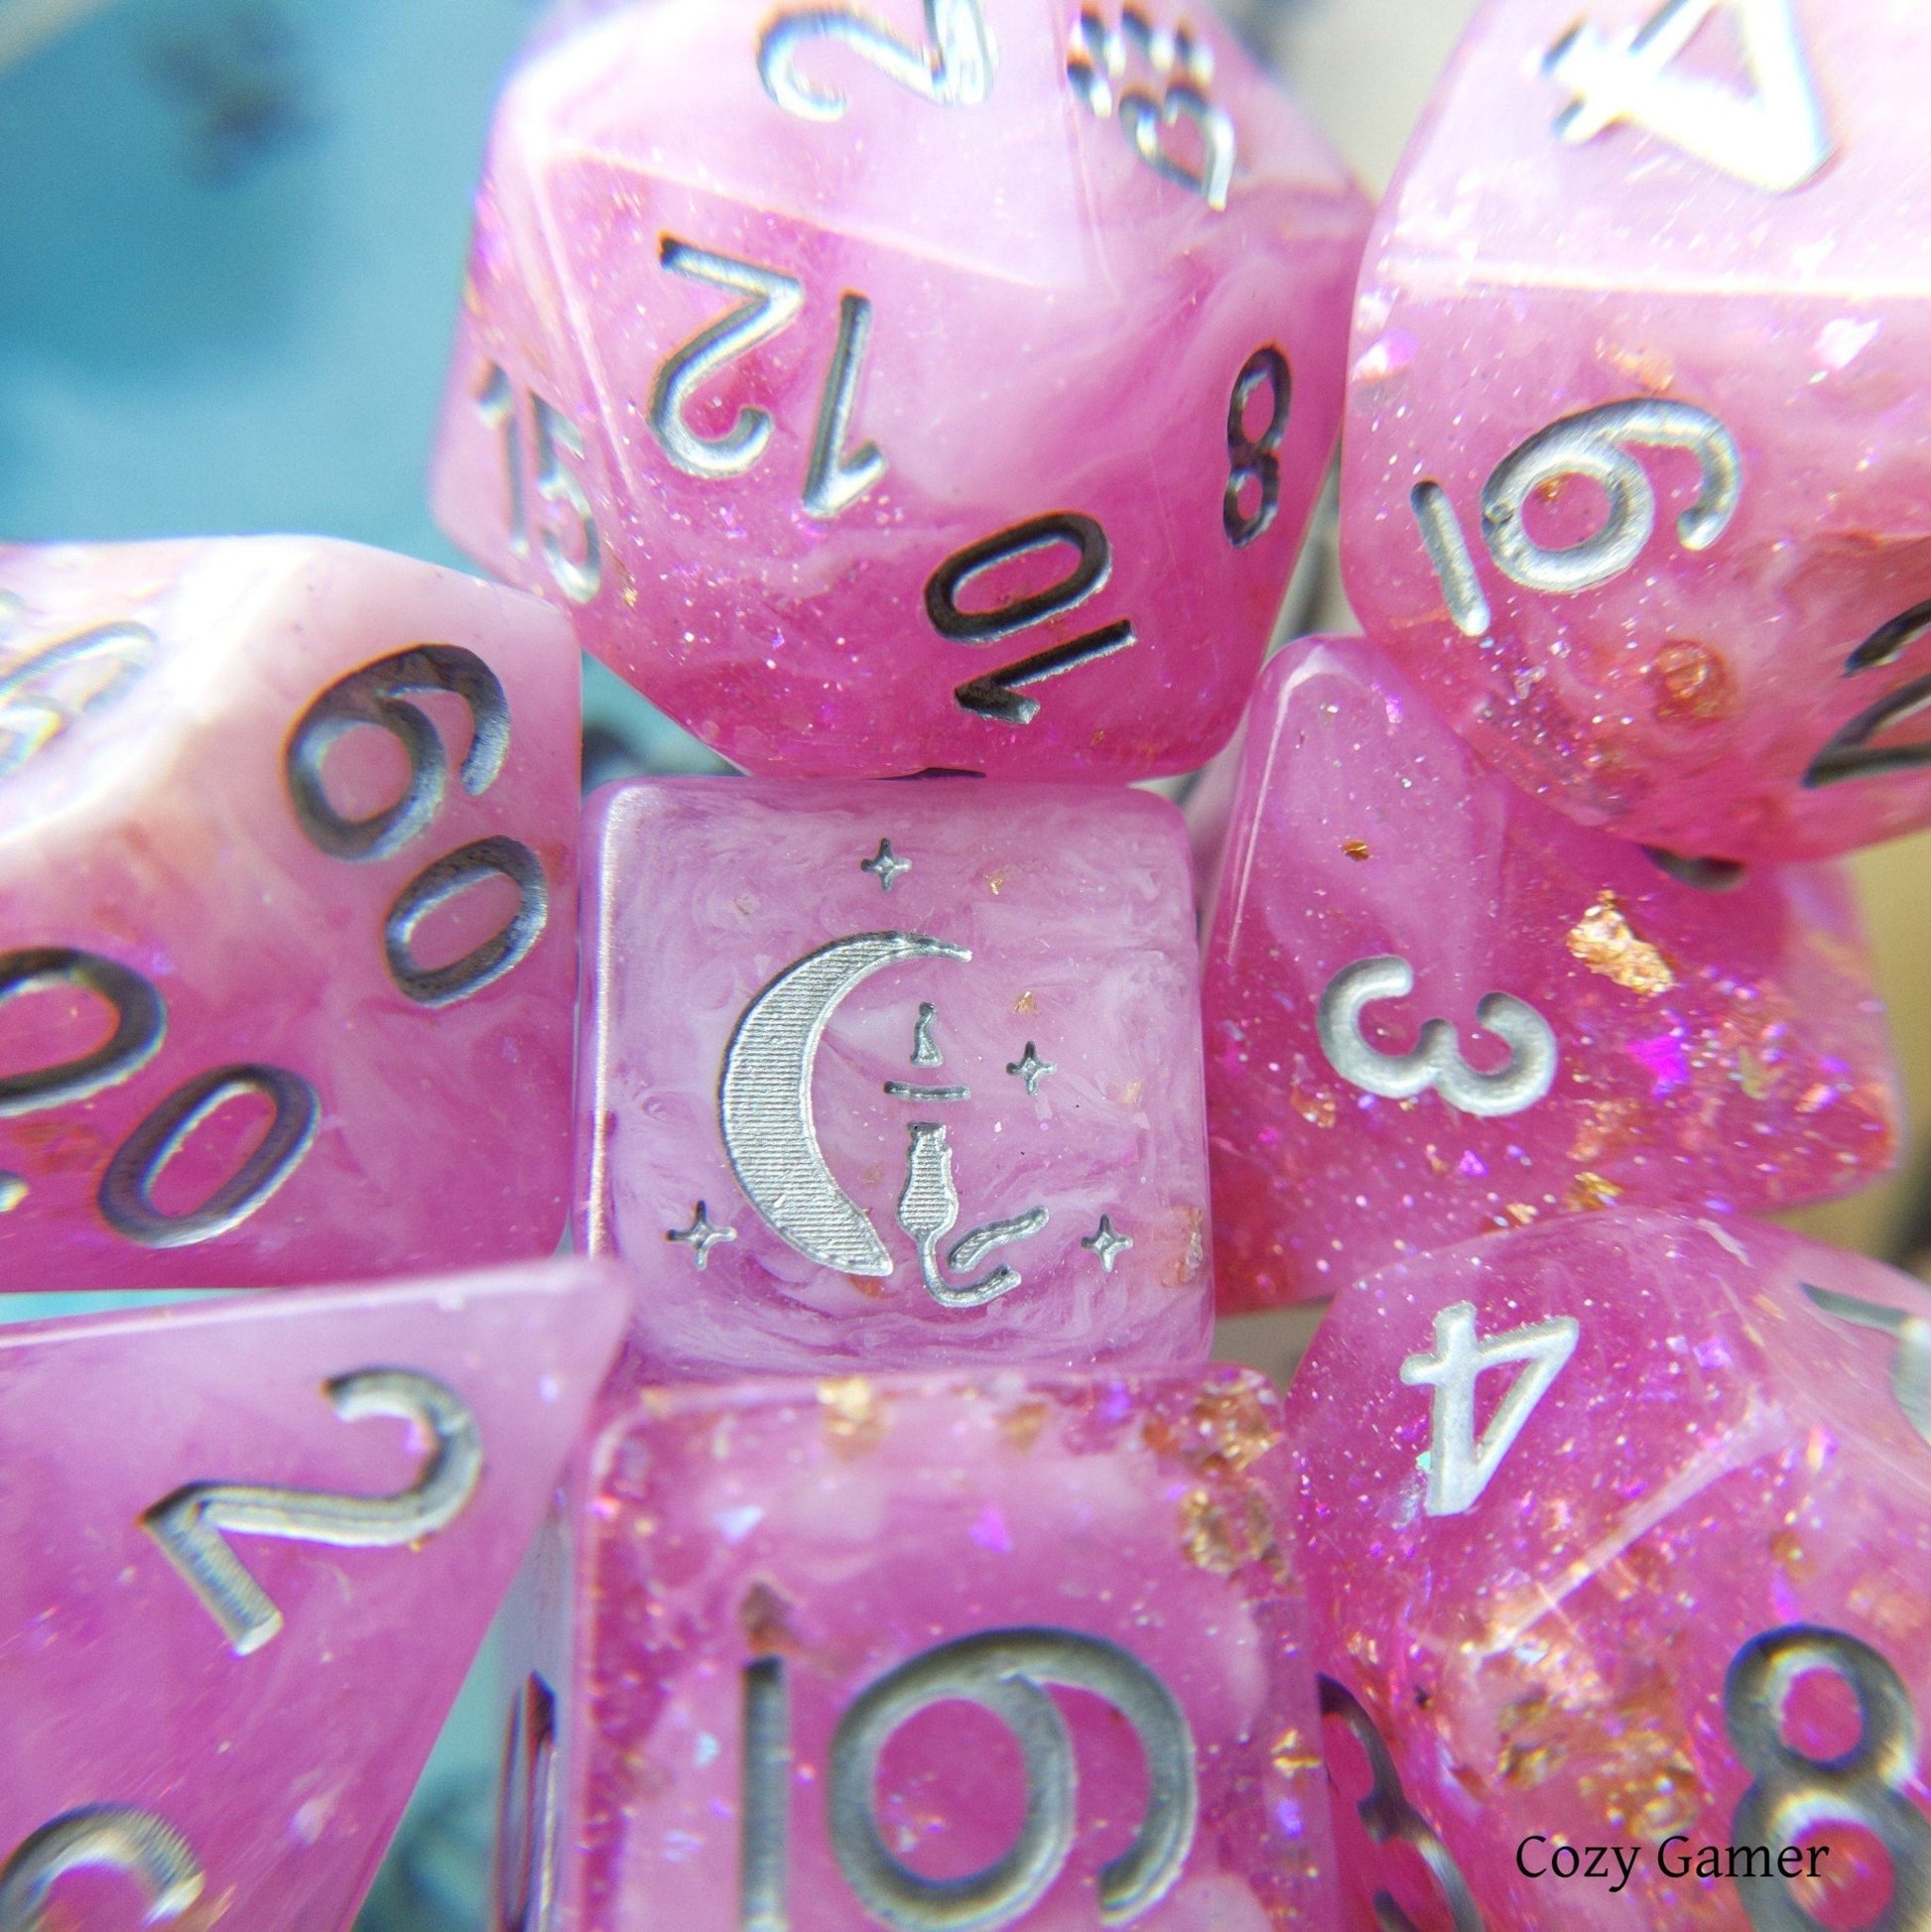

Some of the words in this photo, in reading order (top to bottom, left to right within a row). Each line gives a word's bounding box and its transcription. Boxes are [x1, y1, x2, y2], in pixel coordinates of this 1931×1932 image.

[1541, 0, 1836, 194] 4
[650, 233, 887, 518] 12
[1223, 344, 1291, 547] 8
[924, 512, 1137, 724] 10
[1318, 955, 1557, 1117] 3
[139, 1365, 483, 1657] 2
[1400, 1299, 1580, 1517] 4
[1724, 1622, 1931, 1932] 8
